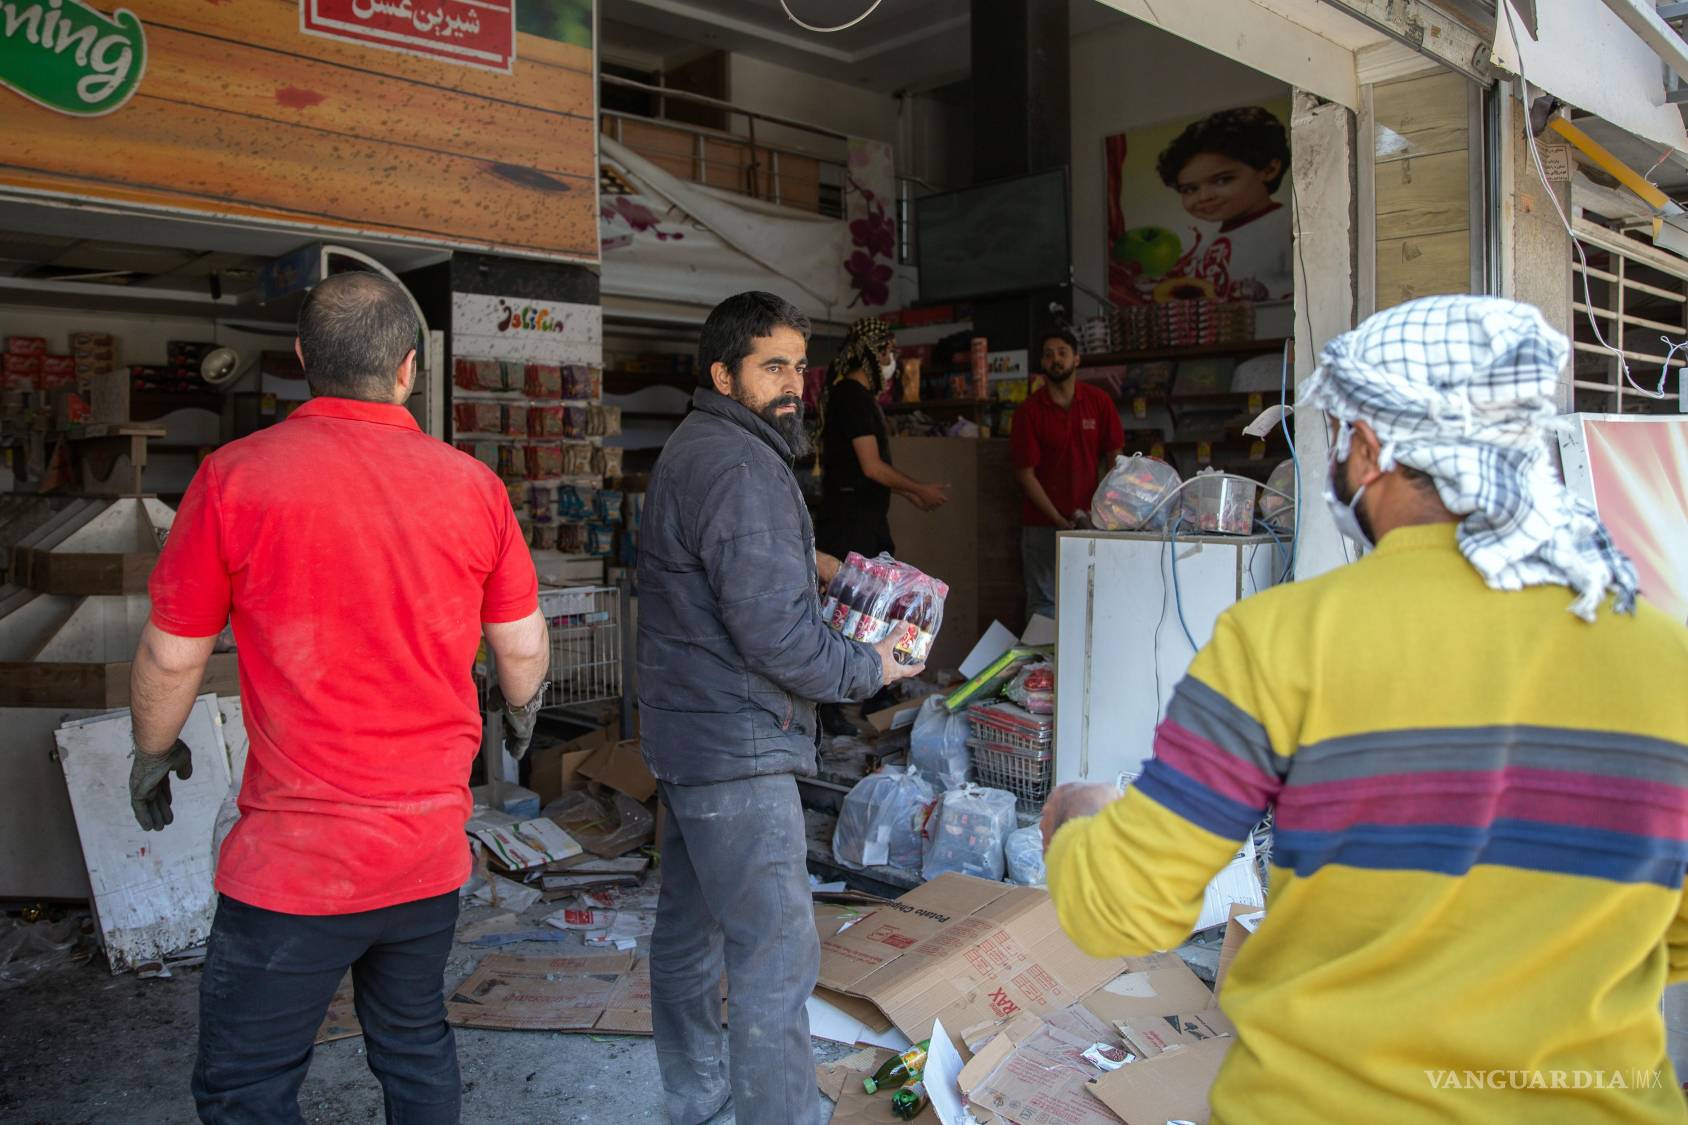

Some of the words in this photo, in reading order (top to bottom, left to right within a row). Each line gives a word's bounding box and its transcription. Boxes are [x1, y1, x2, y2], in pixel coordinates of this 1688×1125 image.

[413, 8, 481, 38] شیرین
[0, 0, 133, 103] ning
[914, 908, 951, 923] Potato
